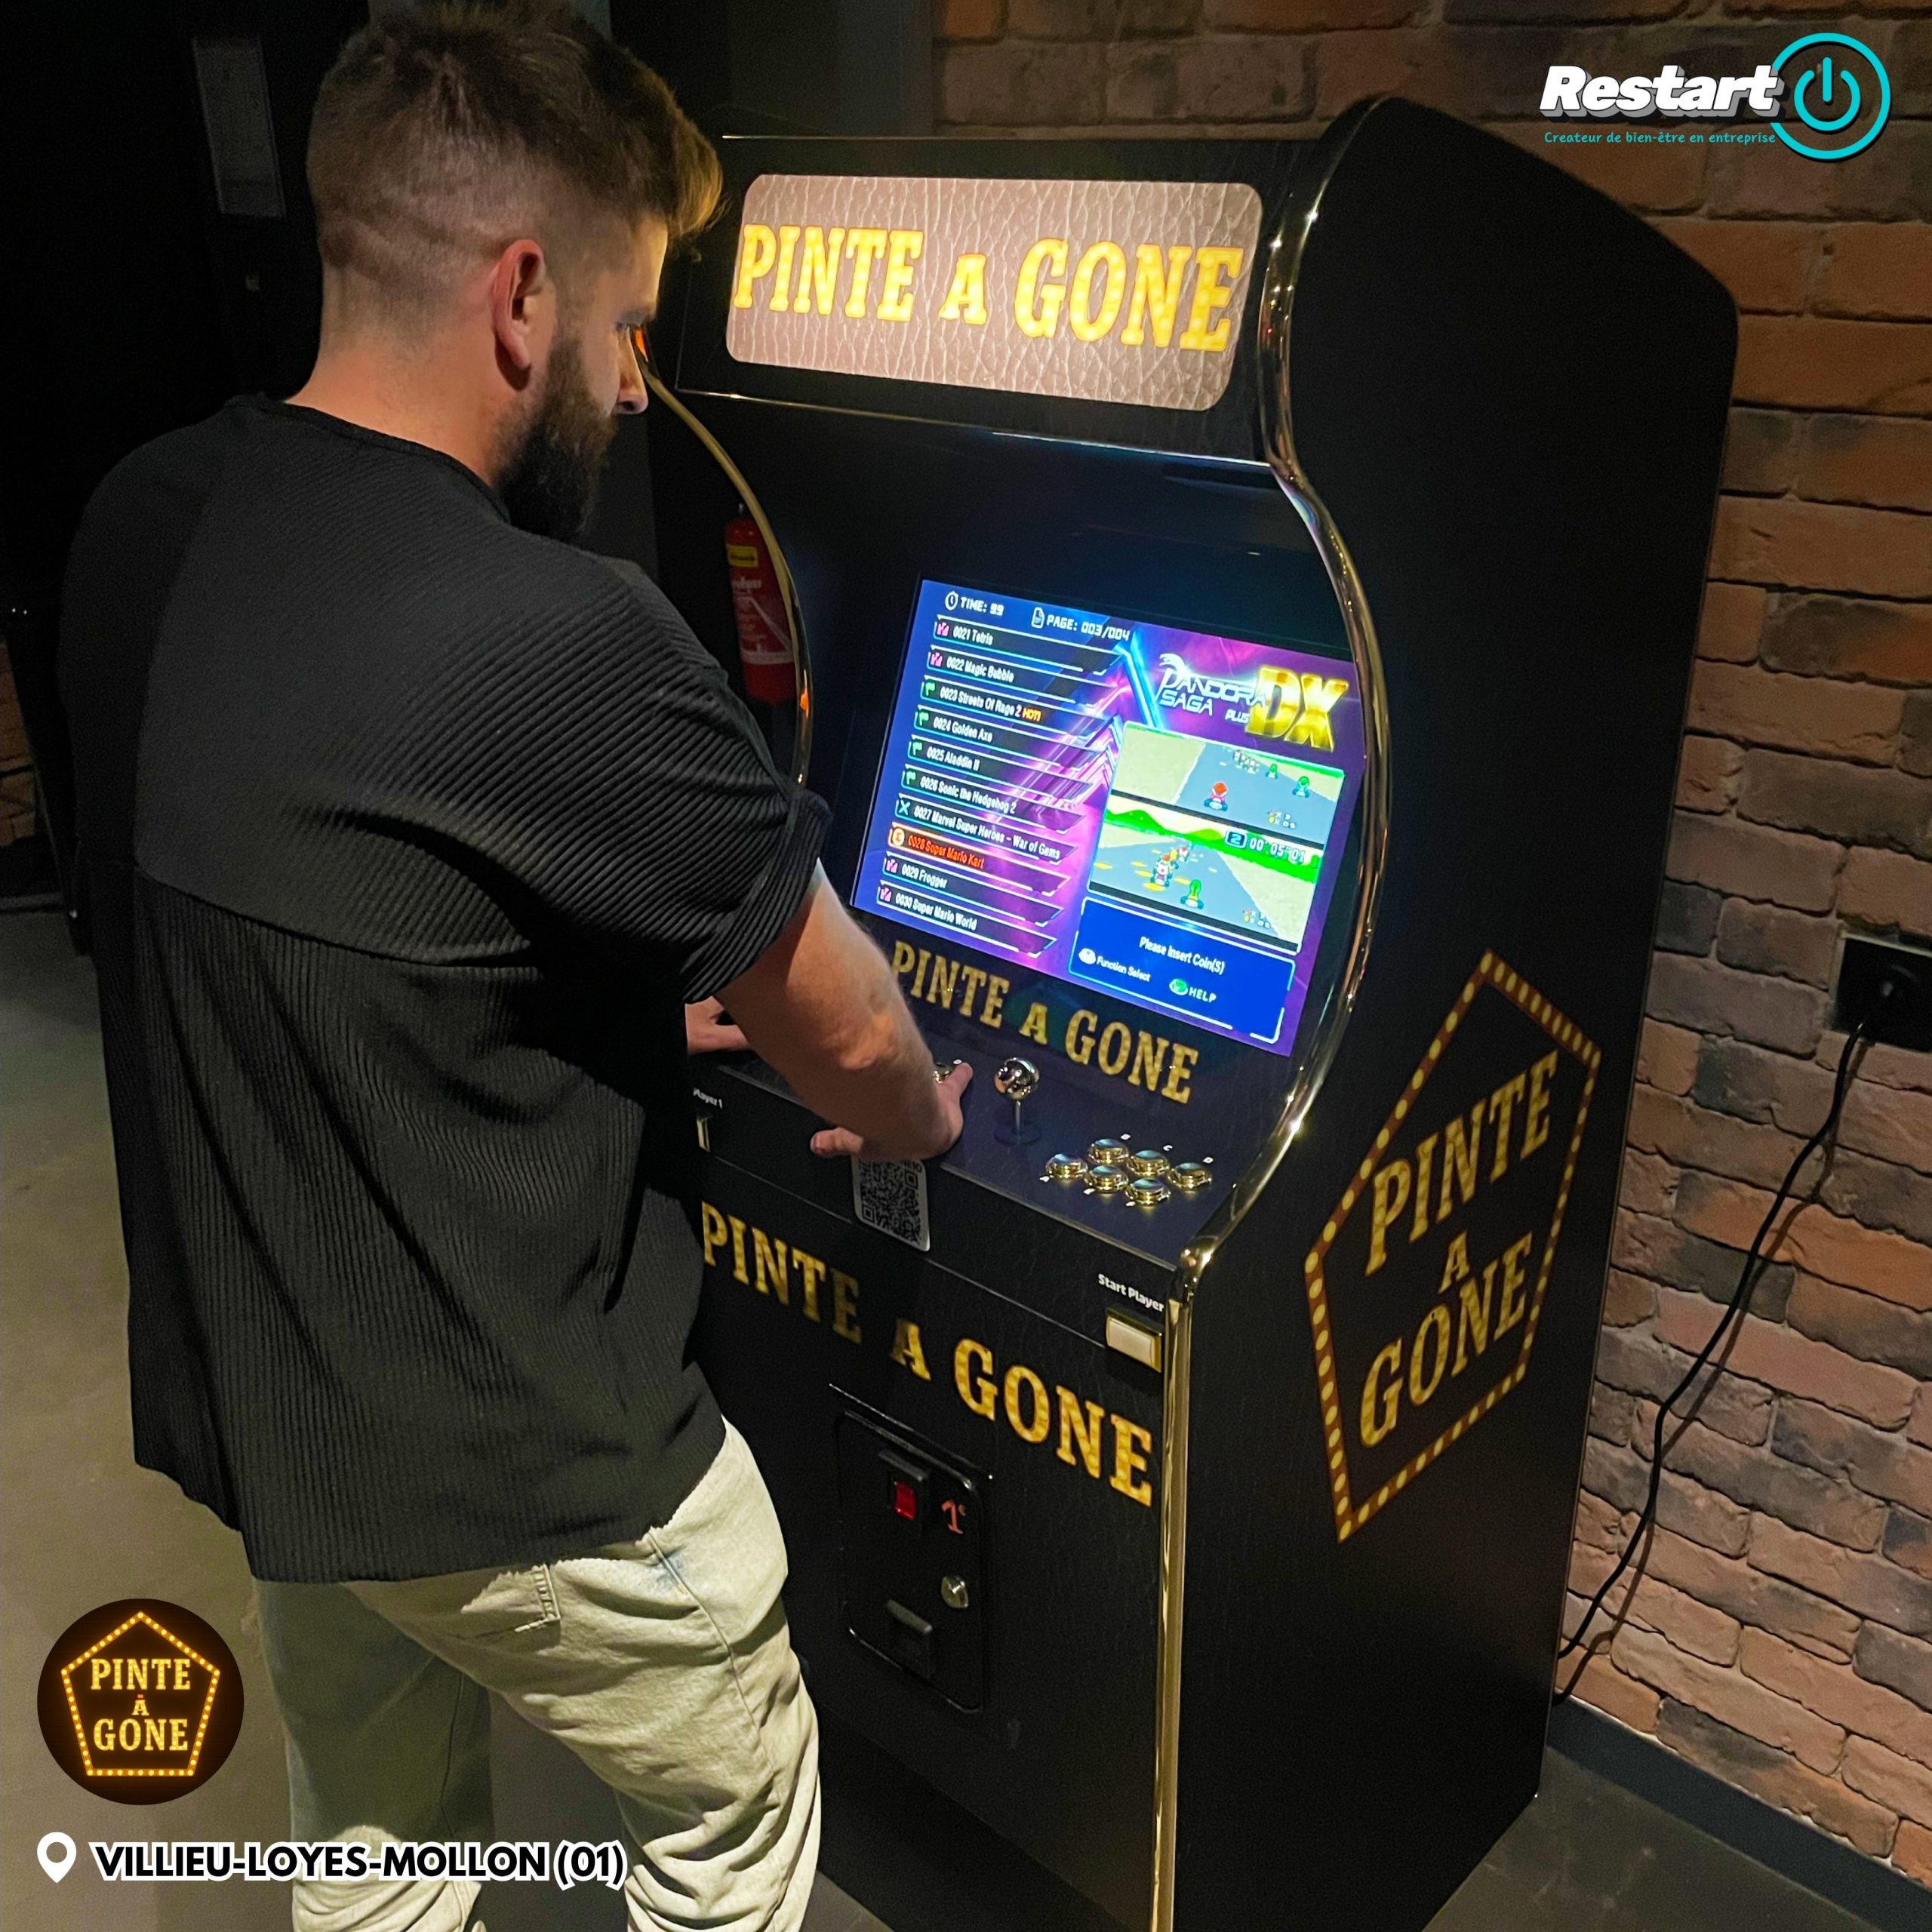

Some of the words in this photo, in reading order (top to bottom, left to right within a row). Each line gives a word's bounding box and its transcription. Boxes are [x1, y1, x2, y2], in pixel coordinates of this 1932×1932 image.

[734, 224, 924, 322] PINTE
[939, 254, 987, 325] A
[1014, 238, 1244, 352] GONE
[960, 596, 987, 612] TIME:
[952, 625, 971, 641] 0021
[971, 628, 994, 645] Tetris
[1047, 614, 1078, 632] PAGE:
[1081, 624, 1131, 641] 003/004
[946, 656, 963, 670] 0022
[964, 659, 986, 677] Magic
[988, 665, 1014, 683] Bubble
[940, 686, 957, 700] 0023
[958, 689, 984, 708] Streets
[995, 698, 1014, 717] Rage
[1014, 703, 1021, 716] 2
[1155, 654, 1268, 708] PANDORA
[1246, 665, 1349, 753] DX
[1159, 689, 1213, 716] SAGA
[1225, 709, 1251, 724] PLUS
[933, 716, 951, 731] 0024
[952, 721, 977, 739] Golden
[977, 728, 993, 743] Axe
[926, 746, 944, 761] 0025
[944, 751, 972, 768] Aladdin
[919, 775, 937, 789] 0026
[938, 779, 959, 797] Sonic
[960, 786, 971, 801] the
[972, 790, 1009, 813] Hedgehog
[1009, 802, 1017, 814] 2
[913, 805, 931, 820] 0027
[931, 810, 955, 828] Marvel
[956, 817, 978, 836] Super
[979, 823, 1004, 843] Heroes
[1013, 835, 1027, 851] War
[1028, 840, 1038, 853] of
[1038, 842, 1060, 860] Gems
[1229, 832, 1242, 845] 2
[908, 835, 925, 851] 0028
[925, 839, 946, 859] Super
[947, 846, 967, 864] Mario
[968, 853, 985, 869] Kart
[901, 864, 918, 879] 0029
[918, 868, 948, 888] Frogger
[895, 892, 913, 908] 0030
[913, 897, 934, 917] Super
[934, 905, 955, 922] Mario
[955, 912, 978, 931] World
[1096, 955, 1127, 974] Function
[1127, 966, 1151, 982] Select
[1140, 936, 1168, 955] Please
[1168, 945, 1192, 964] Insert
[1192, 953, 1226, 975] Coin(S)
[1189, 986, 1217, 1003] HELP
[892, 940, 1010, 1029] PINTE
[1020, 1004, 1048, 1046] A
[1066, 1008, 1199, 1105] GONE
[1365, 1050, 1558, 1278] PINTE
[1438, 1230, 1469, 1294] A
[1098, 1273, 1127, 1296] Start
[1128, 1287, 1164, 1312] Player
[701, 1201, 862, 1345] PINTE
[888, 1318, 931, 1381] A
[953, 1338, 1152, 1508] GONE
[1361, 1232, 1534, 1447] GONE
